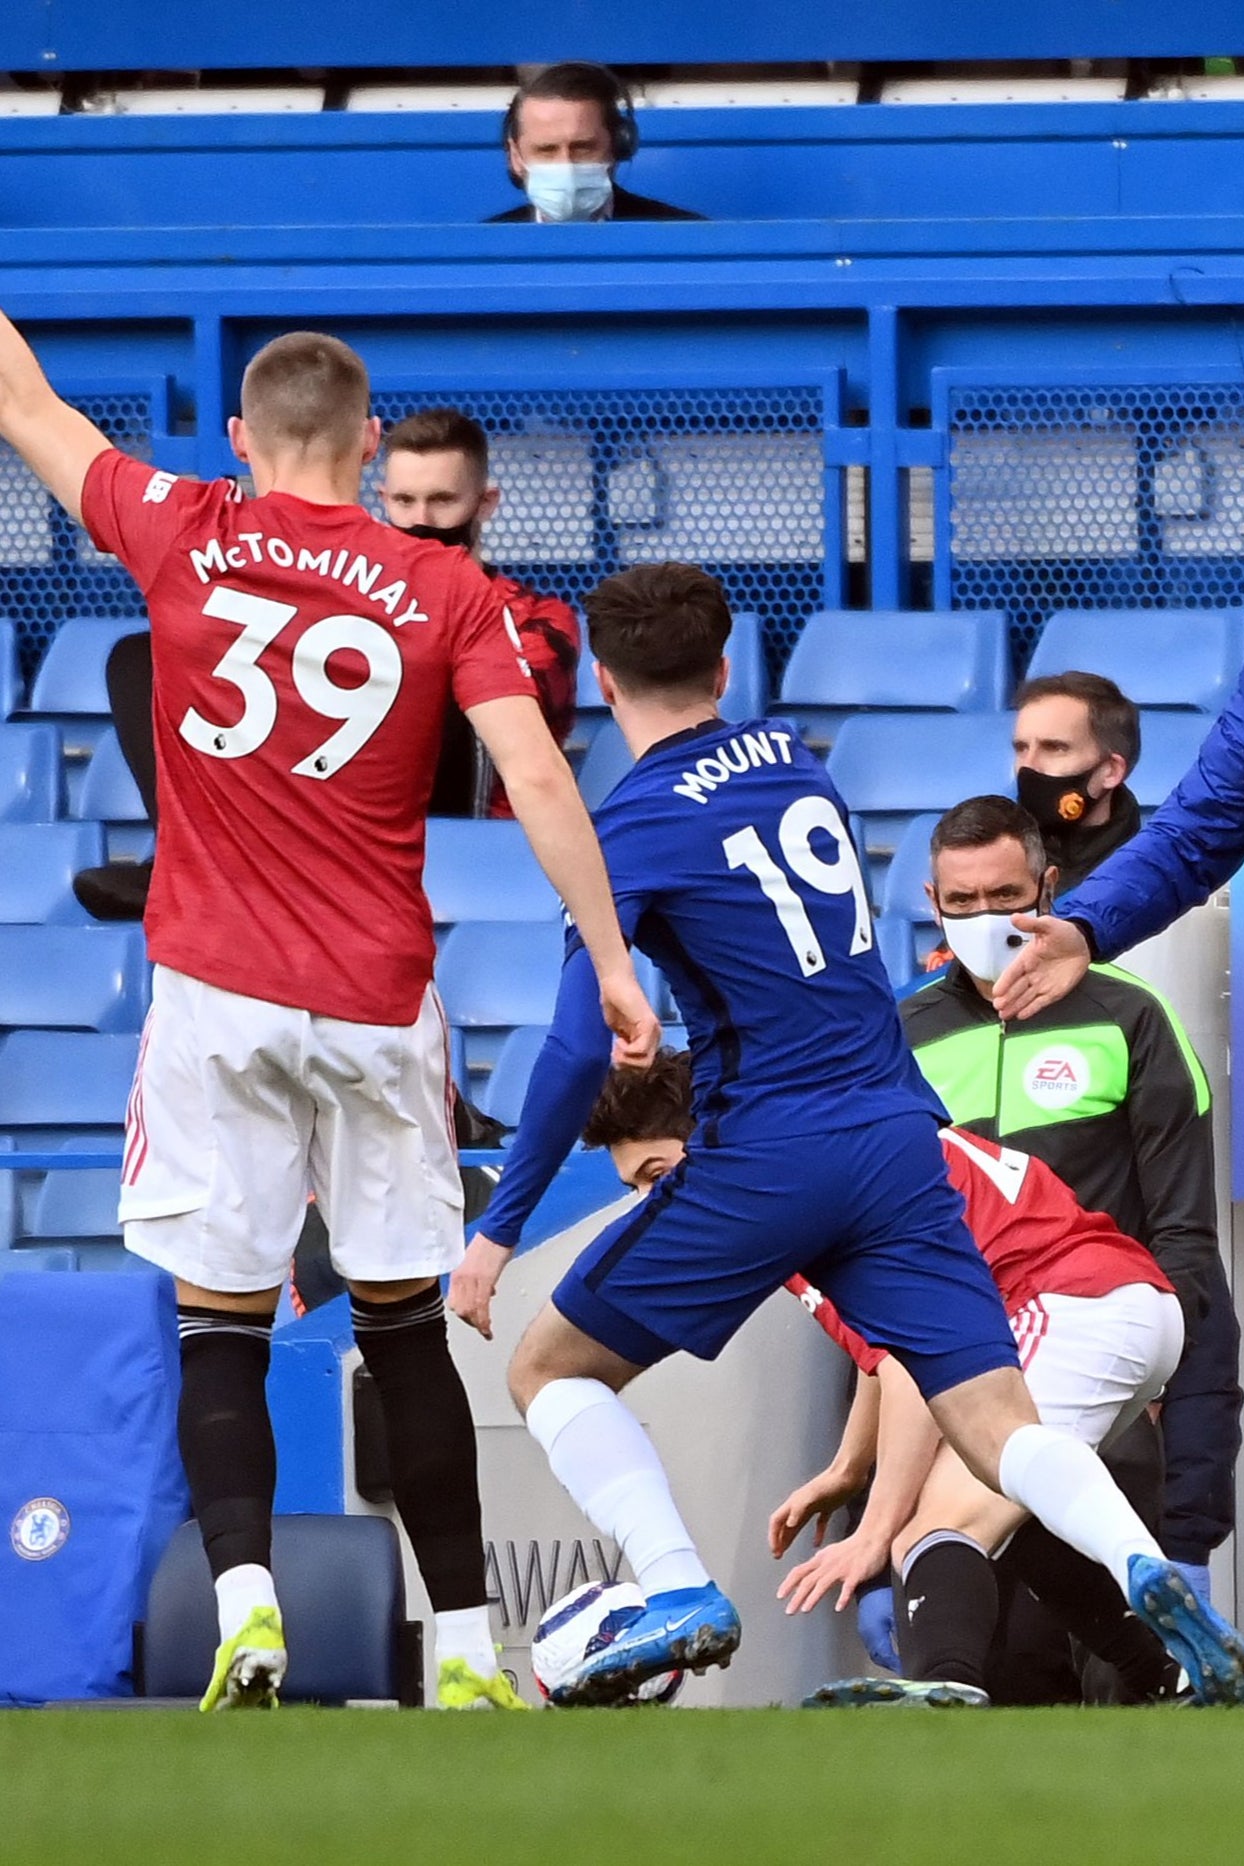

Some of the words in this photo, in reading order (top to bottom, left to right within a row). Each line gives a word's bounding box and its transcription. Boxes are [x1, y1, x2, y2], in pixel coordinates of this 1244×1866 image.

[189, 532, 429, 627] McTOMINAY
[178, 585, 403, 780] 39
[673, 731, 792, 805] MOUNT
[722, 795, 873, 978] 19
[1031, 1080, 1078, 1092] SPORTS
[1035, 1060, 1077, 1082] EA
